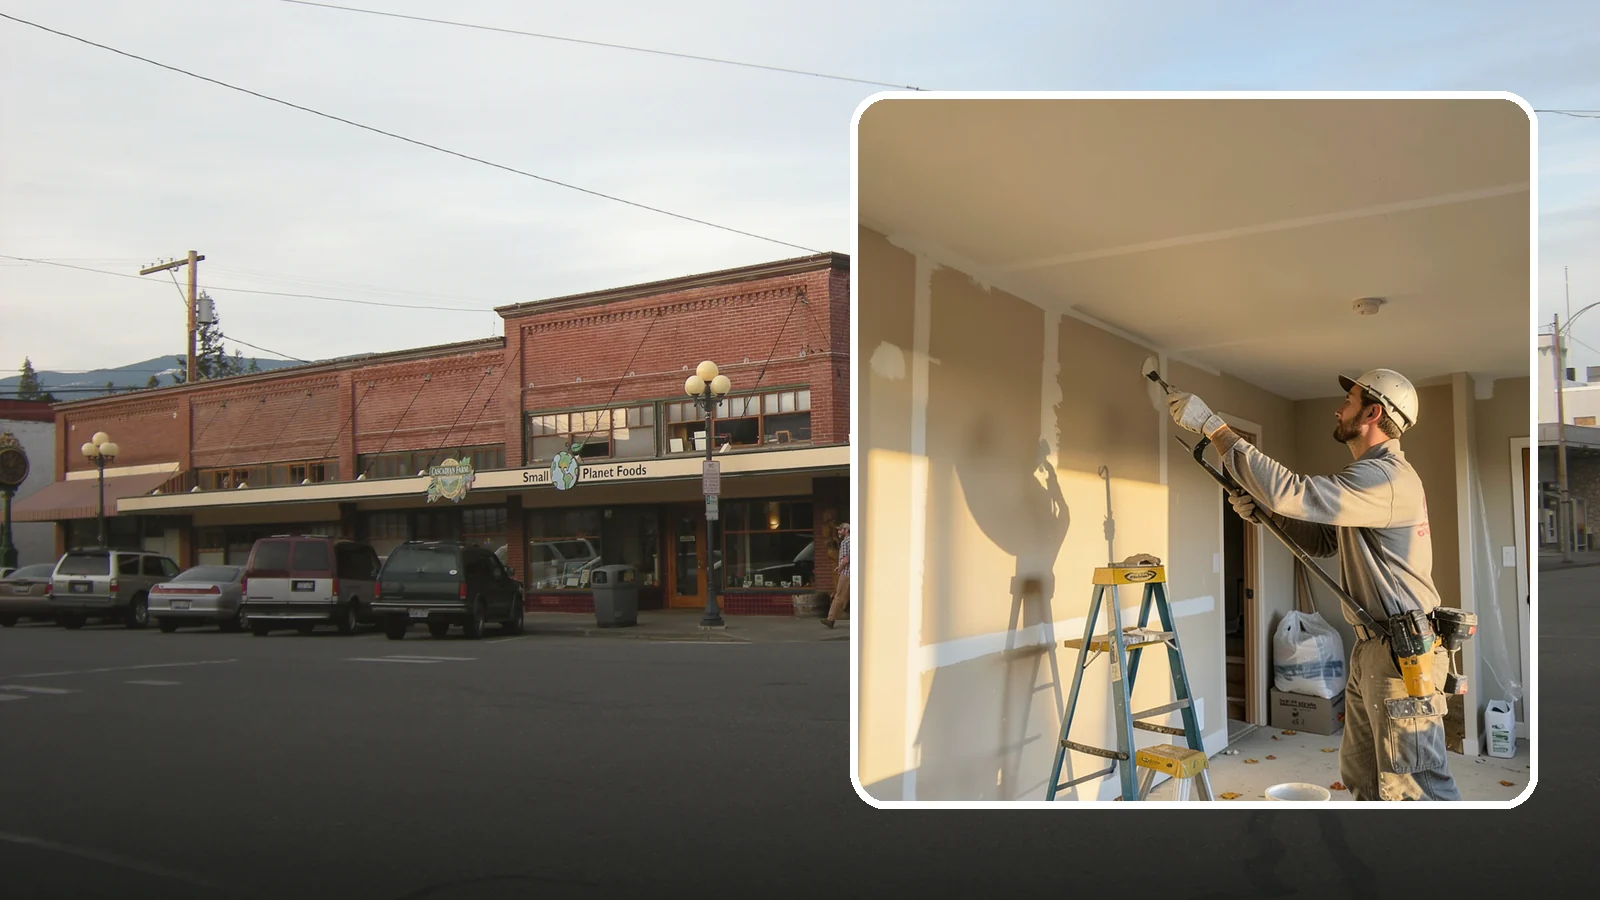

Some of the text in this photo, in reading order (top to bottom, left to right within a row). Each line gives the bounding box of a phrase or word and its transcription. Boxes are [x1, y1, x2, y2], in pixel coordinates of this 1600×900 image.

[523, 464, 647, 483] Small Planet Foods
